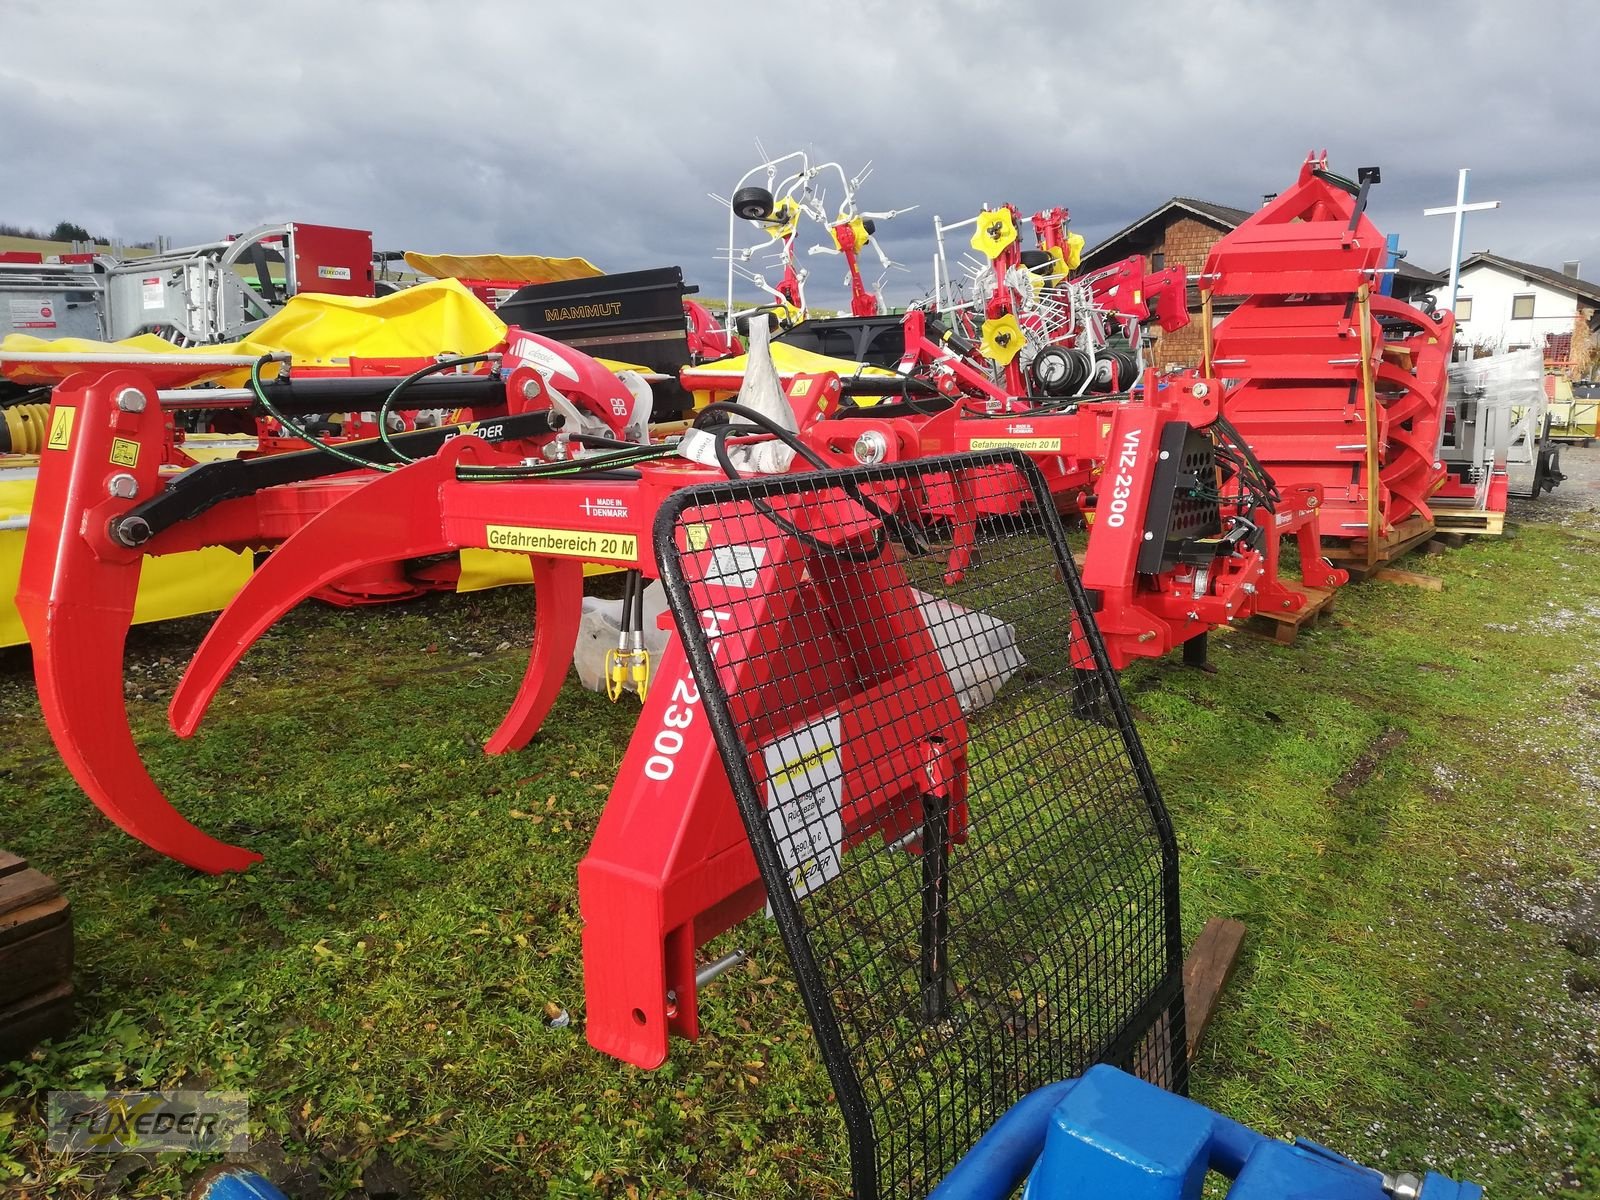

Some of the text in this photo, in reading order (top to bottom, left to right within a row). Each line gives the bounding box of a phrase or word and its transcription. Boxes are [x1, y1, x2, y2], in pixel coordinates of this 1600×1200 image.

[544, 302, 622, 321] MAMMUT
[971, 440, 1059, 450] Gefahrenbereich 20 M
[1107, 429, 1142, 527] VHZ-2300
[597, 498, 615, 506] MADE
[592, 508, 629, 518] DENMARK
[489, 530, 634, 556] Gefahrenbereich 20 M
